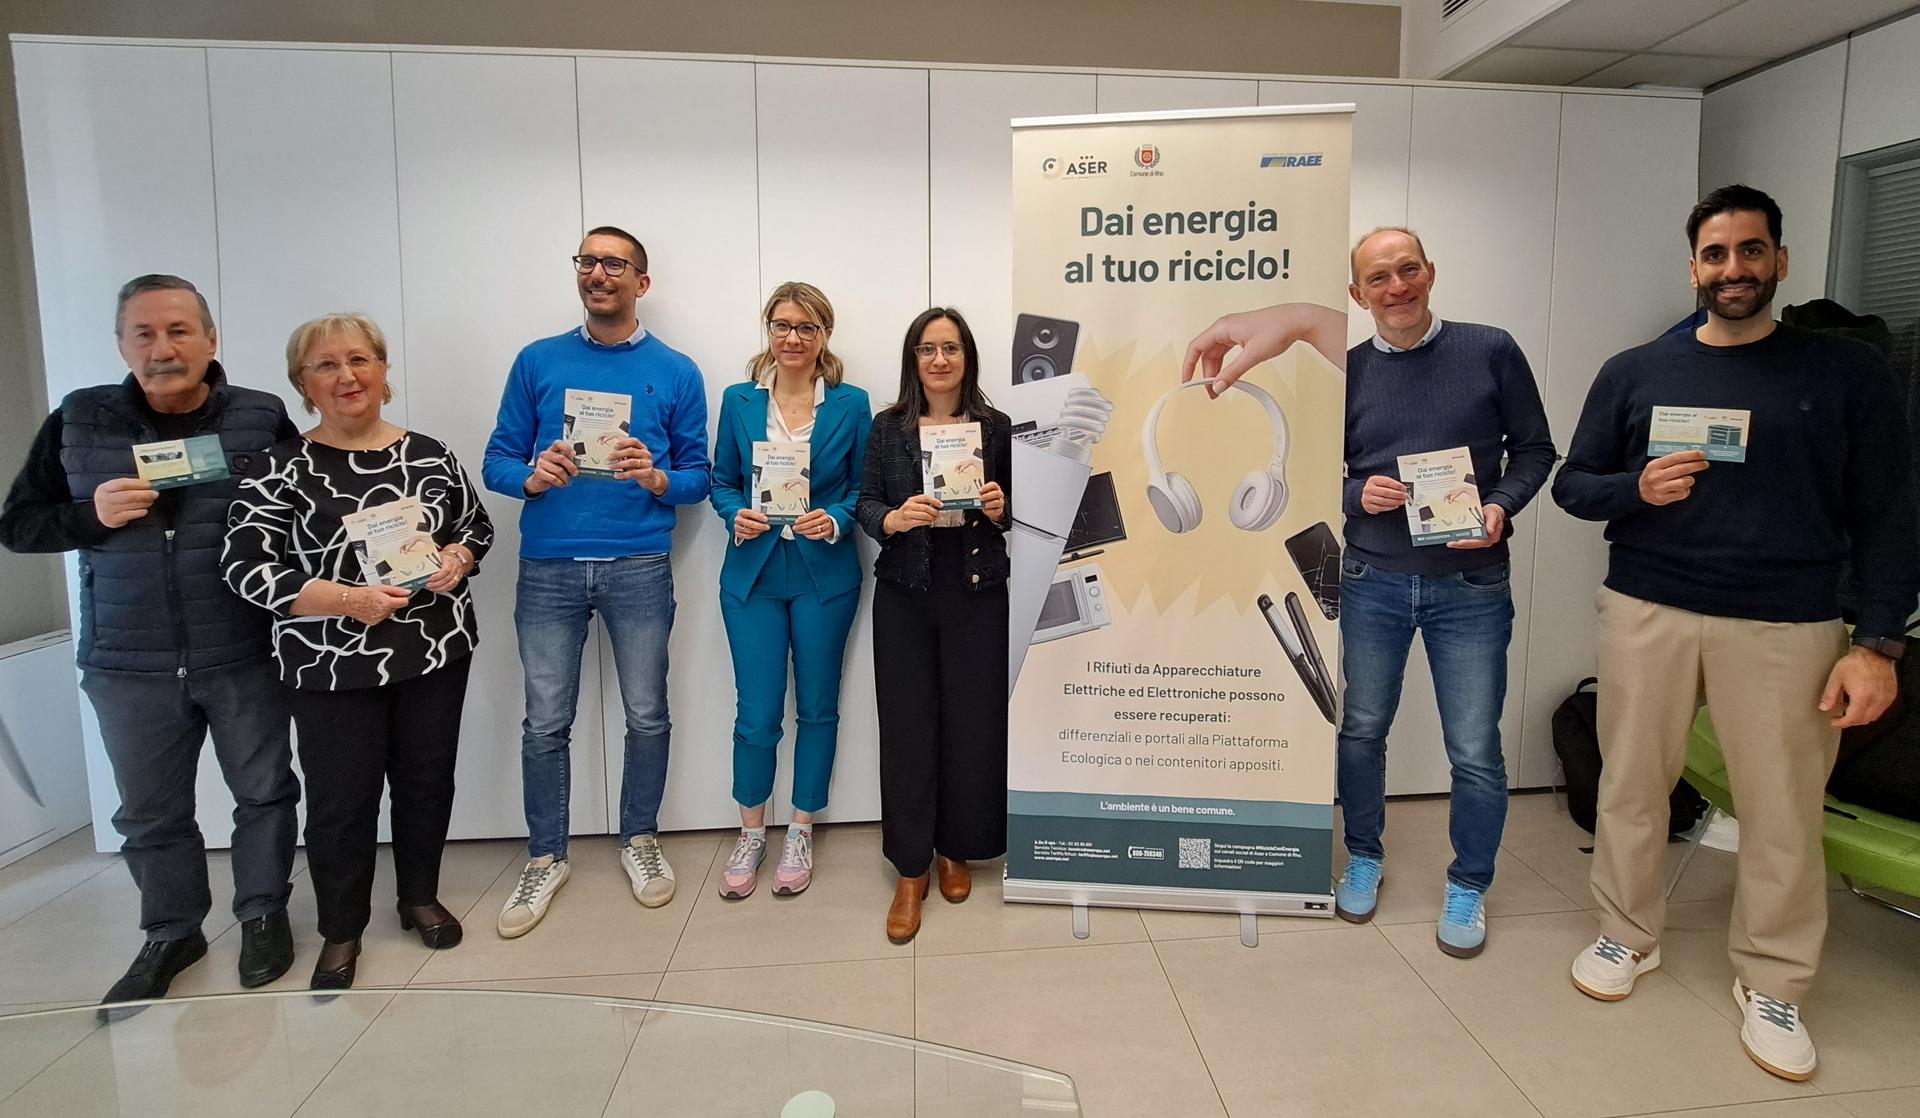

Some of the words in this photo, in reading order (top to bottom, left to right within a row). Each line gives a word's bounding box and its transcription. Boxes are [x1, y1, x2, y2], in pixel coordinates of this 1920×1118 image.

[1066, 161, 1108, 176] ASER
[1286, 156, 1322, 167] RAEE
[1081, 204, 1134, 236] Dai
[1142, 200, 1278, 241] energia
[1064, 253, 1093, 284] al
[1102, 254, 1159, 282] tuo
[1168, 249, 1290, 282] riciclo!
[1087, 661, 1090, 672] I
[1094, 661, 1132, 674] Rifiuti
[1134, 663, 1150, 674] da
[1152, 664, 1262, 678] Apparecchiature
[1064, 684, 1126, 697] Elettriche
[1128, 686, 1144, 698] ed
[1147, 686, 1226, 700] Elettroniche
[1229, 692, 1285, 702] possono
[1114, 710, 1157, 720] essere
[1160, 712, 1231, 724] recuperati:
[1059, 729, 1131, 743] differenziali
[1134, 734, 1142, 743] e
[1145, 733, 1185, 746] portali
[1188, 734, 1209, 746] alla
[1212, 734, 1288, 748] Piattaforma
[1062, 751, 1122, 767] Ecologica
[1125, 757, 1132, 766] o
[1136, 755, 1154, 766] nei
[1157, 757, 1226, 769] contenitori
[1229, 760, 1284, 772] appositi.
[1100, 801, 1150, 812] L'ambiente
[1151, 803, 1157, 812] è
[1172, 805, 1194, 814] bene
[1196, 806, 1236, 816] comune.
